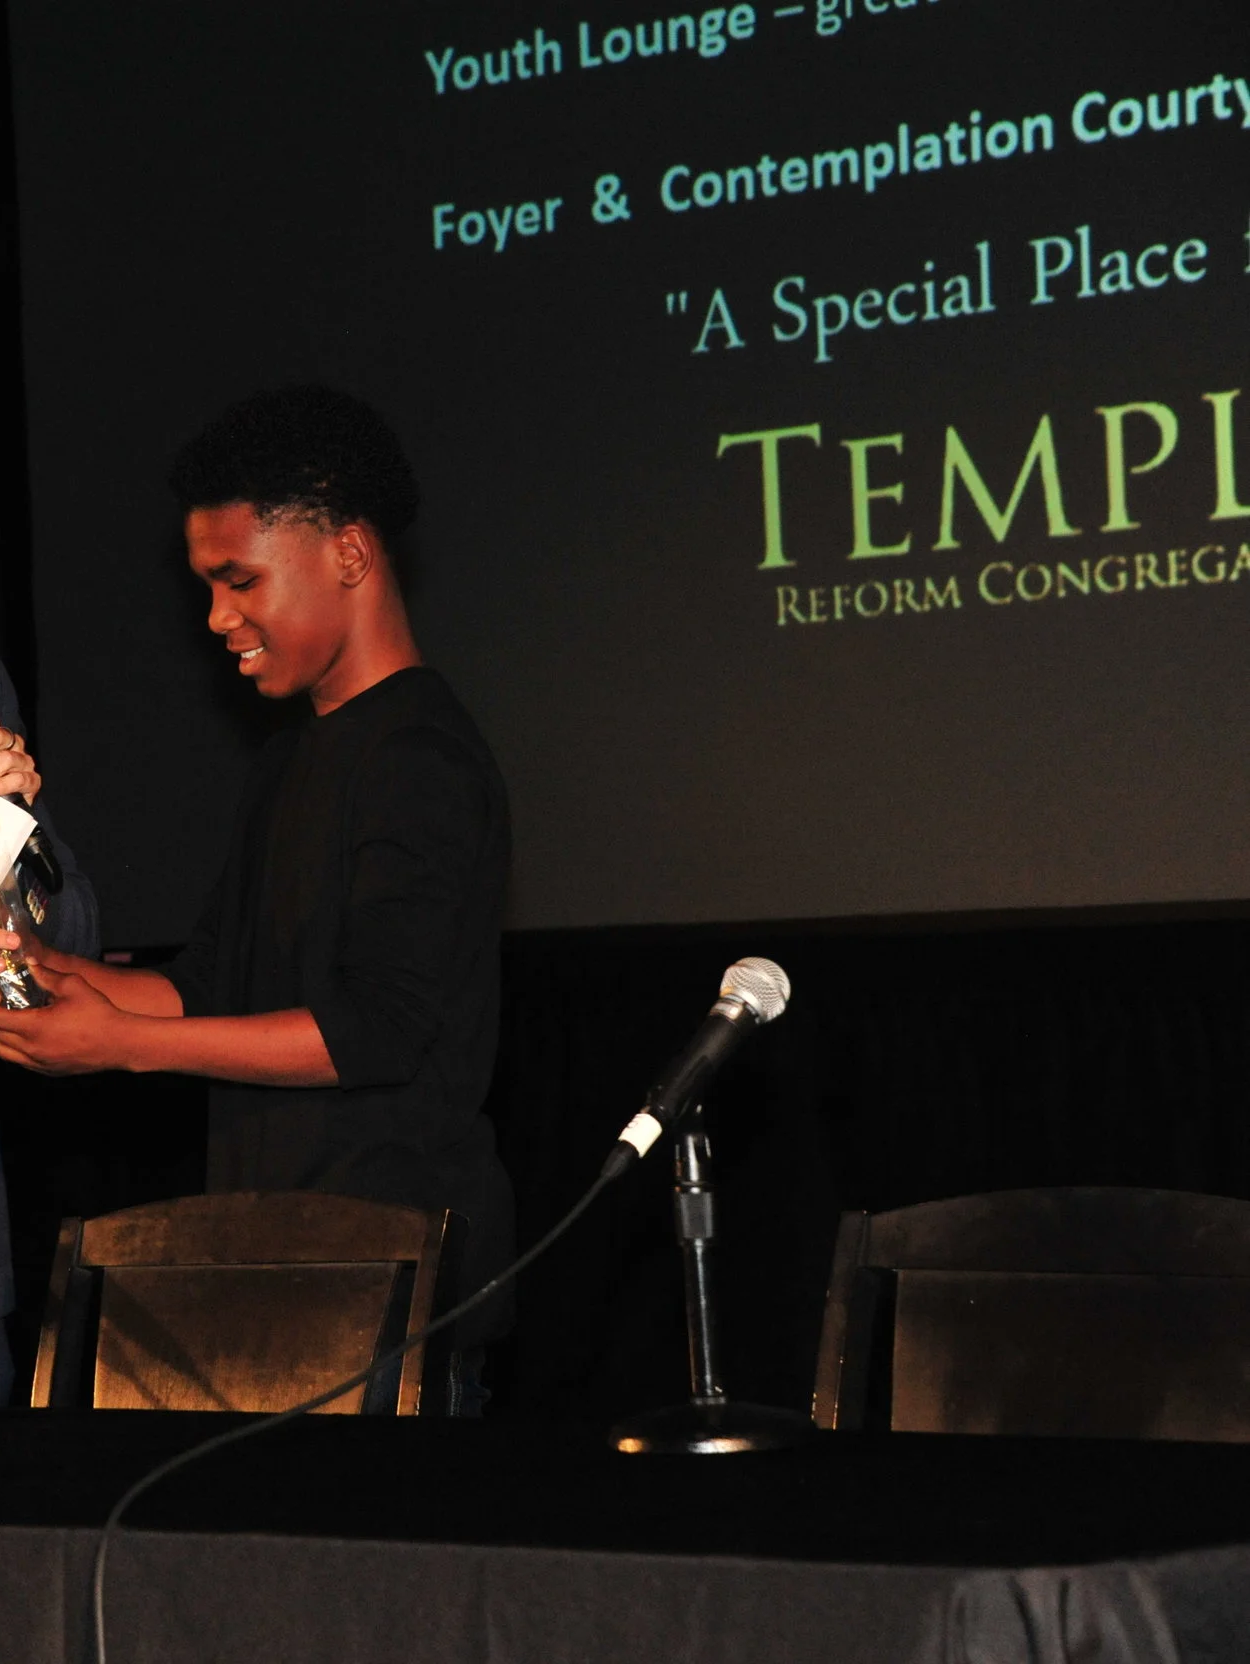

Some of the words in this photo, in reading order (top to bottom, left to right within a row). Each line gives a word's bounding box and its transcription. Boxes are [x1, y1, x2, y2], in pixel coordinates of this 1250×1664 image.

[424, 27, 562, 94] Youth
[578, 3, 756, 69] Lounge
[432, 197, 563, 253] Foyer
[591, 173, 631, 224] &
[660, 109, 1054, 212] Contemplation
[772, 240, 996, 364] Special
[1028, 224, 1208, 306] Place
[776, 575, 963, 627] REFORM
